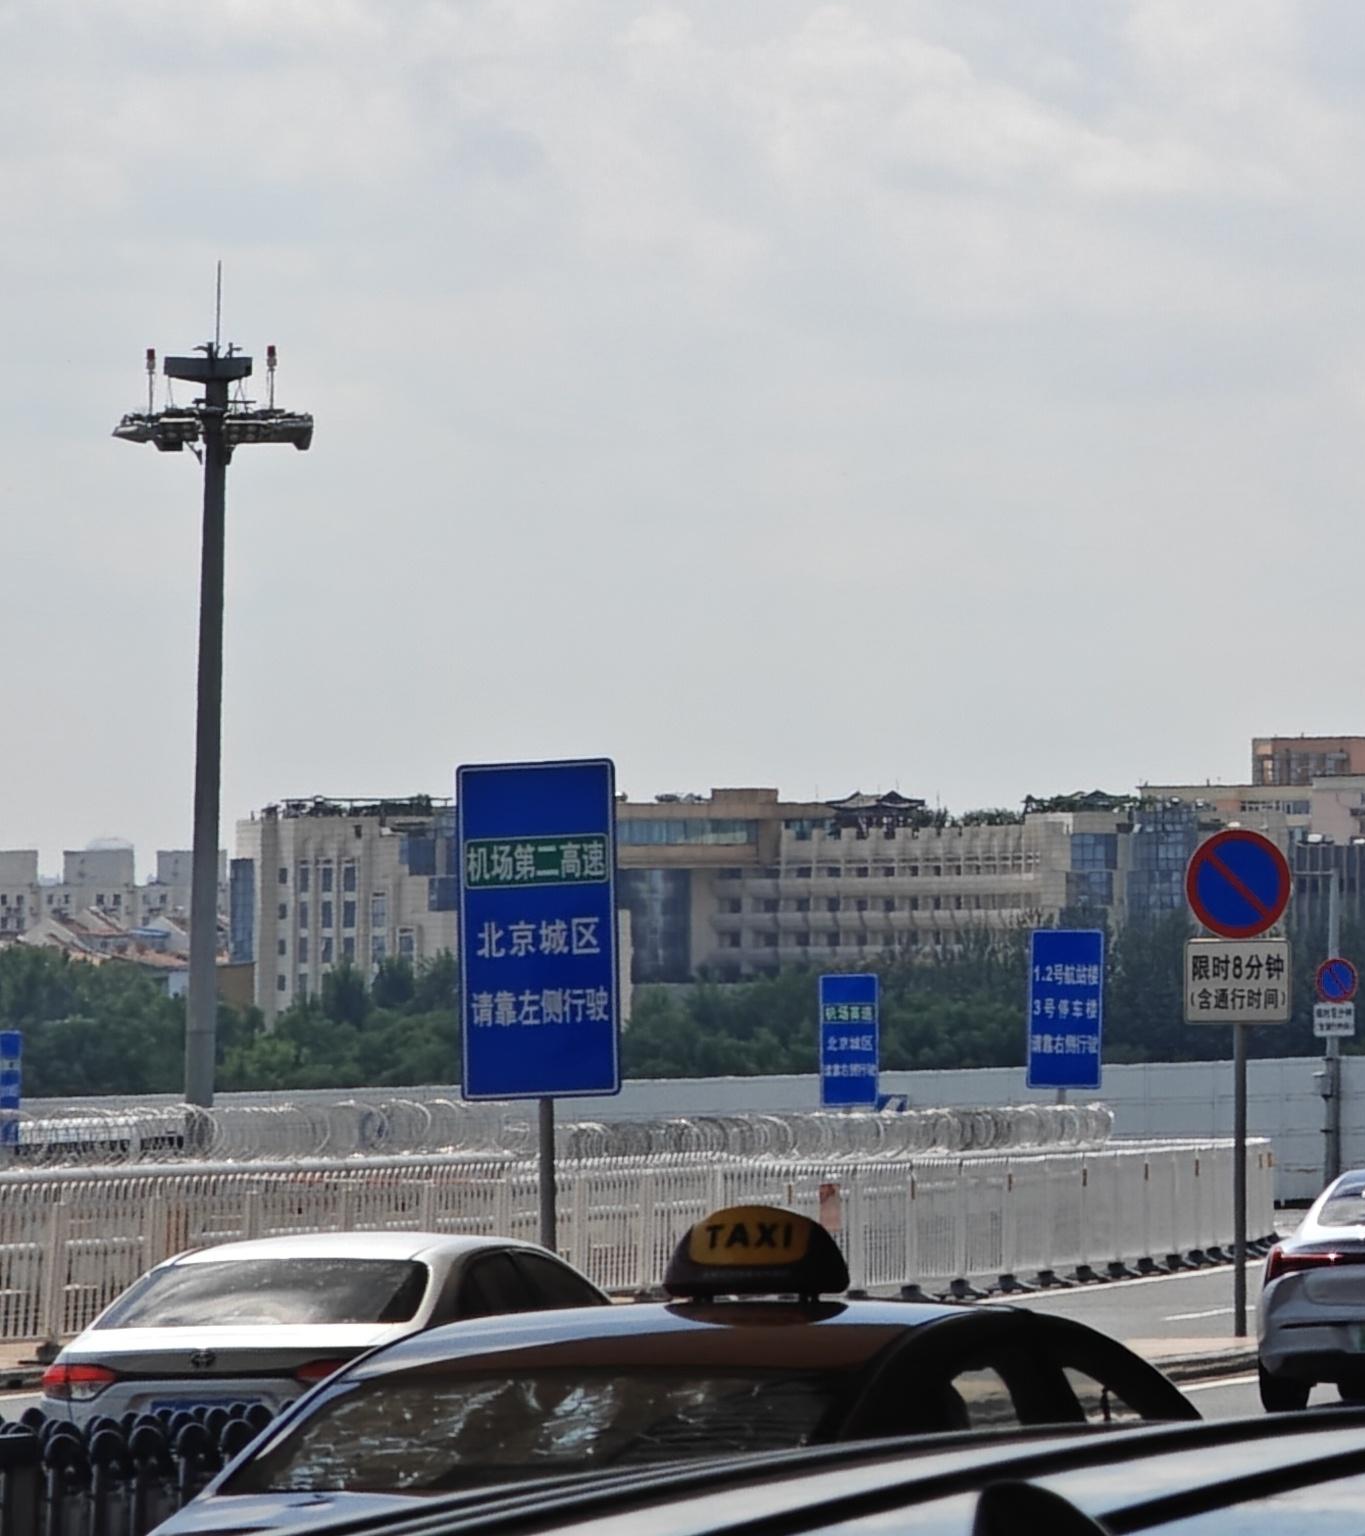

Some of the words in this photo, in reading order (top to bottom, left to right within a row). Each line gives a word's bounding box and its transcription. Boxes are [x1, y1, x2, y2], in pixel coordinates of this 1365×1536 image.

[467, 839, 606, 883] 机场第二高速
[476, 917, 601, 959] 北京城区
[1191, 953, 1285, 982] 限时8分钟
[471, 985, 610, 1027] 请靠左侧行驶
[1033, 997, 1098, 1019] 3号停车楼
[826, 1035, 874, 1052] 北京城区
[1031, 1033, 1099, 1054] 请靠右侧行驶
[706, 1222, 793, 1250] TAXI
